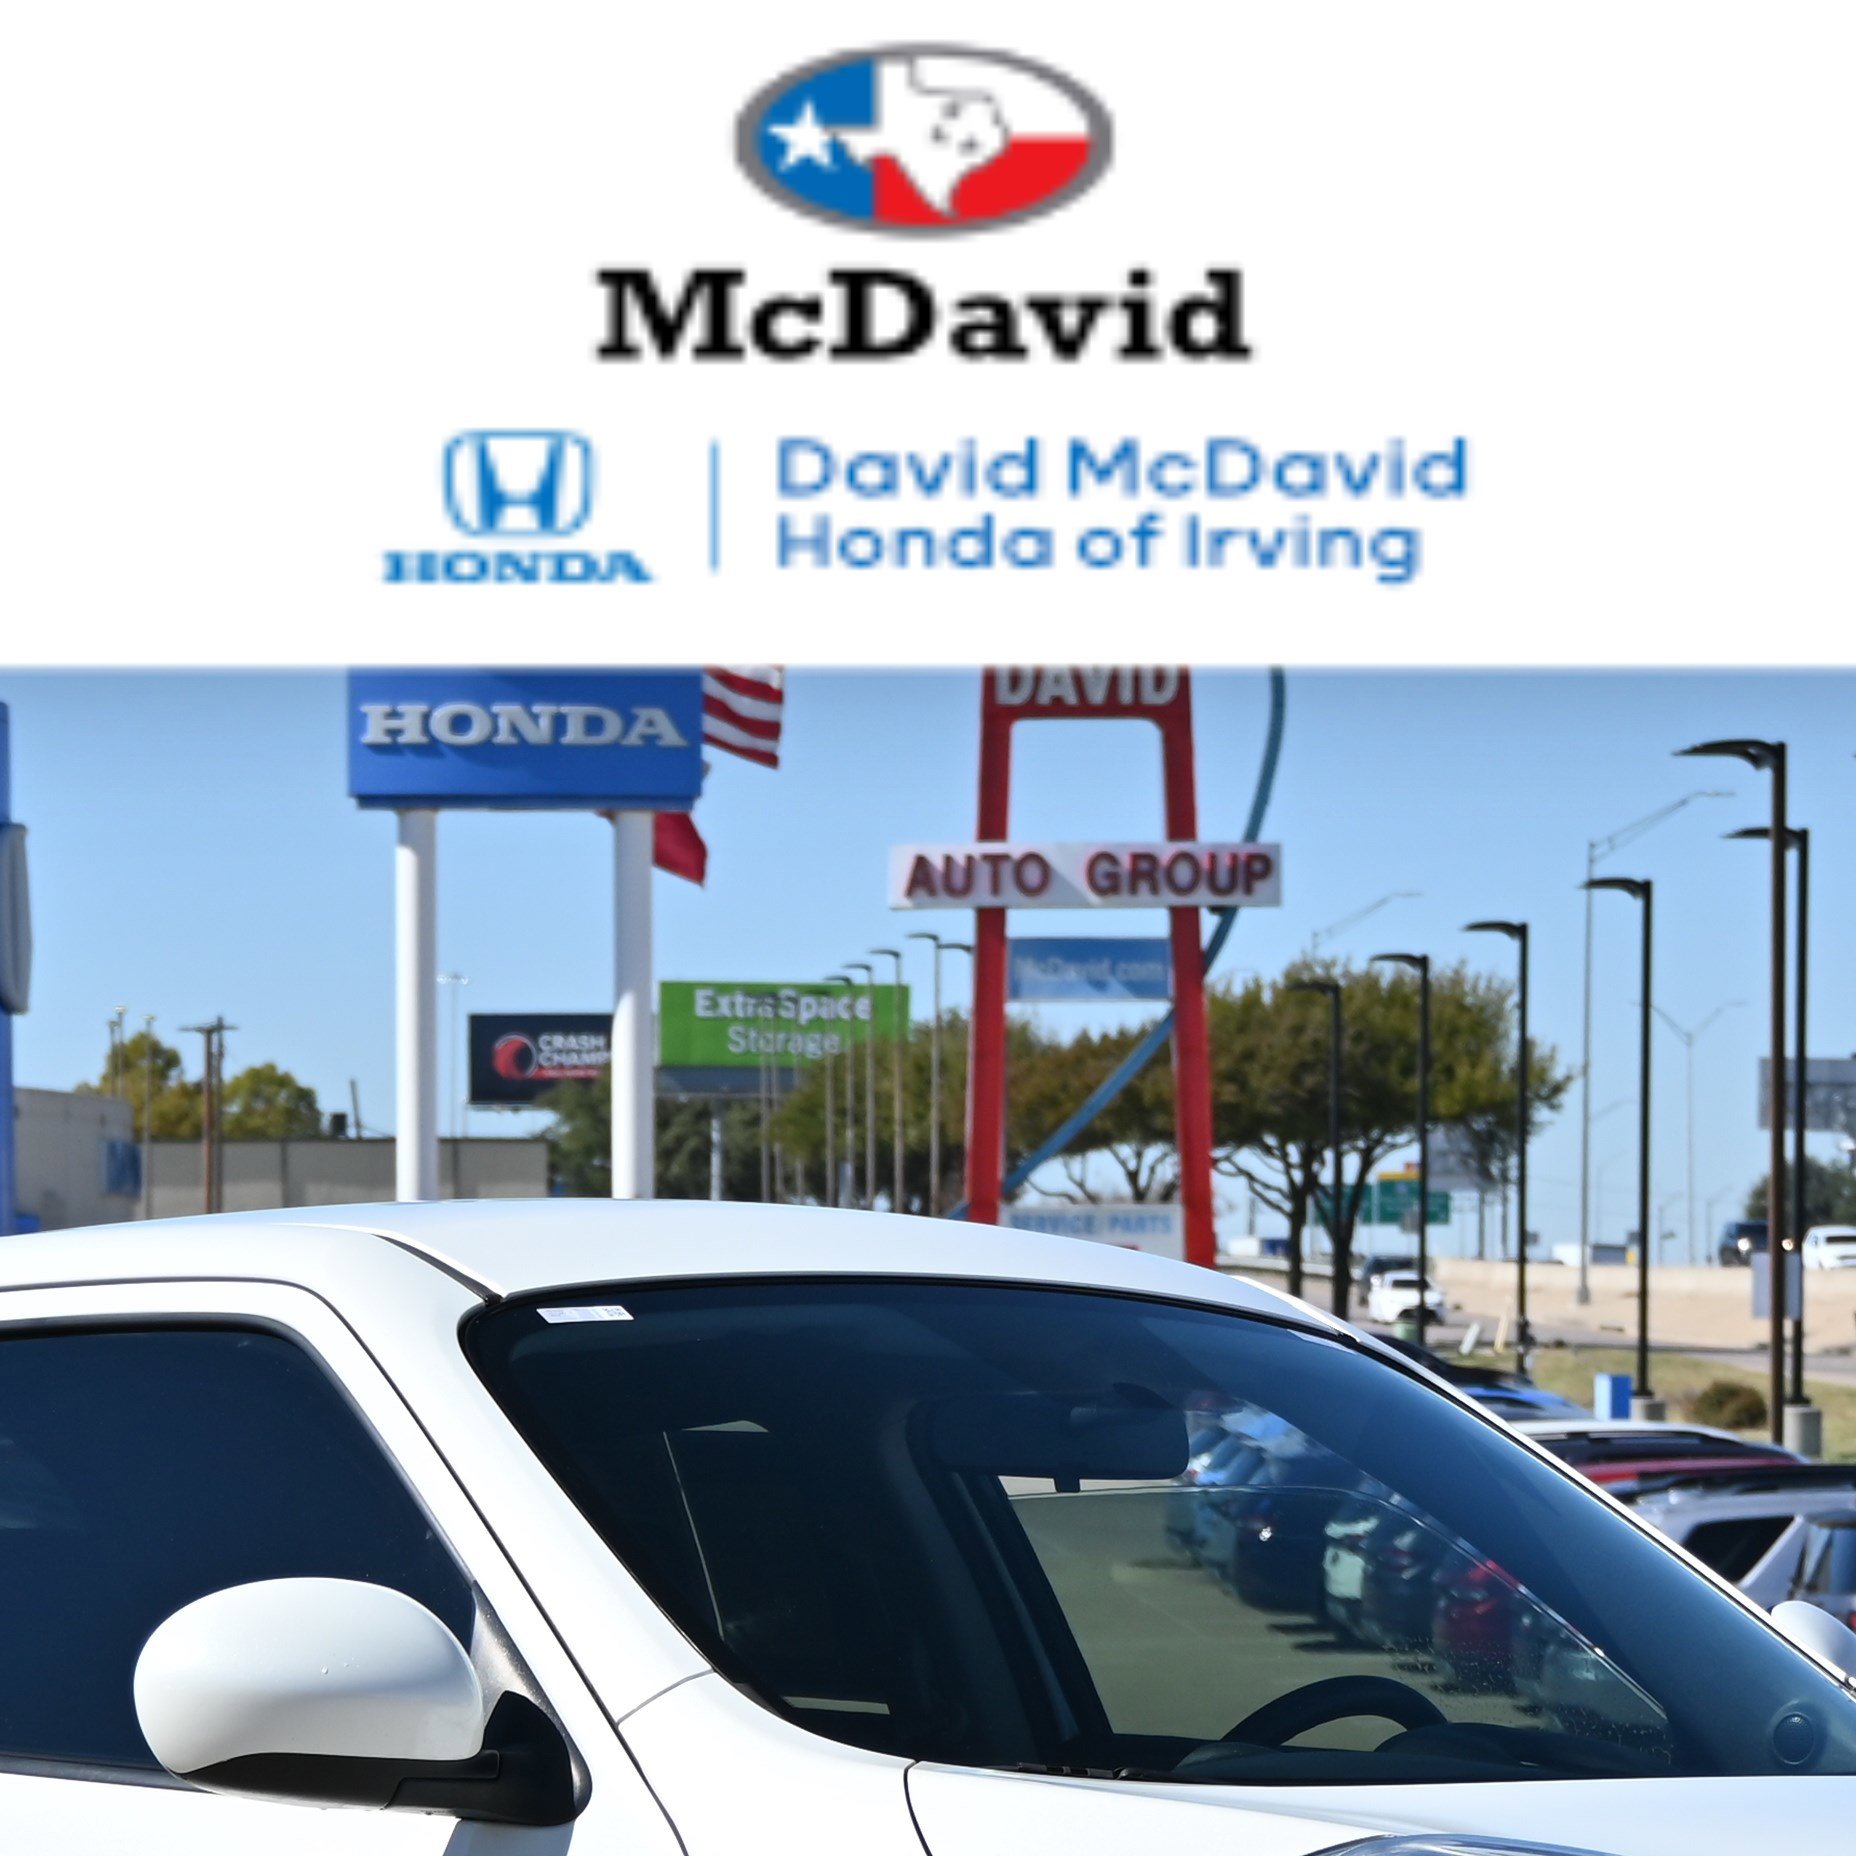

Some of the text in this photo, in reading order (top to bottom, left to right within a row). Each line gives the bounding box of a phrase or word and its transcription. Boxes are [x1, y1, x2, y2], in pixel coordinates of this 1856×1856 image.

[360, 703, 689, 746] HONDA
[905, 850, 1274, 898] AUTO GROUP
[538, 1033, 606, 1051] CRASH
[727, 1024, 841, 1060] Storage
